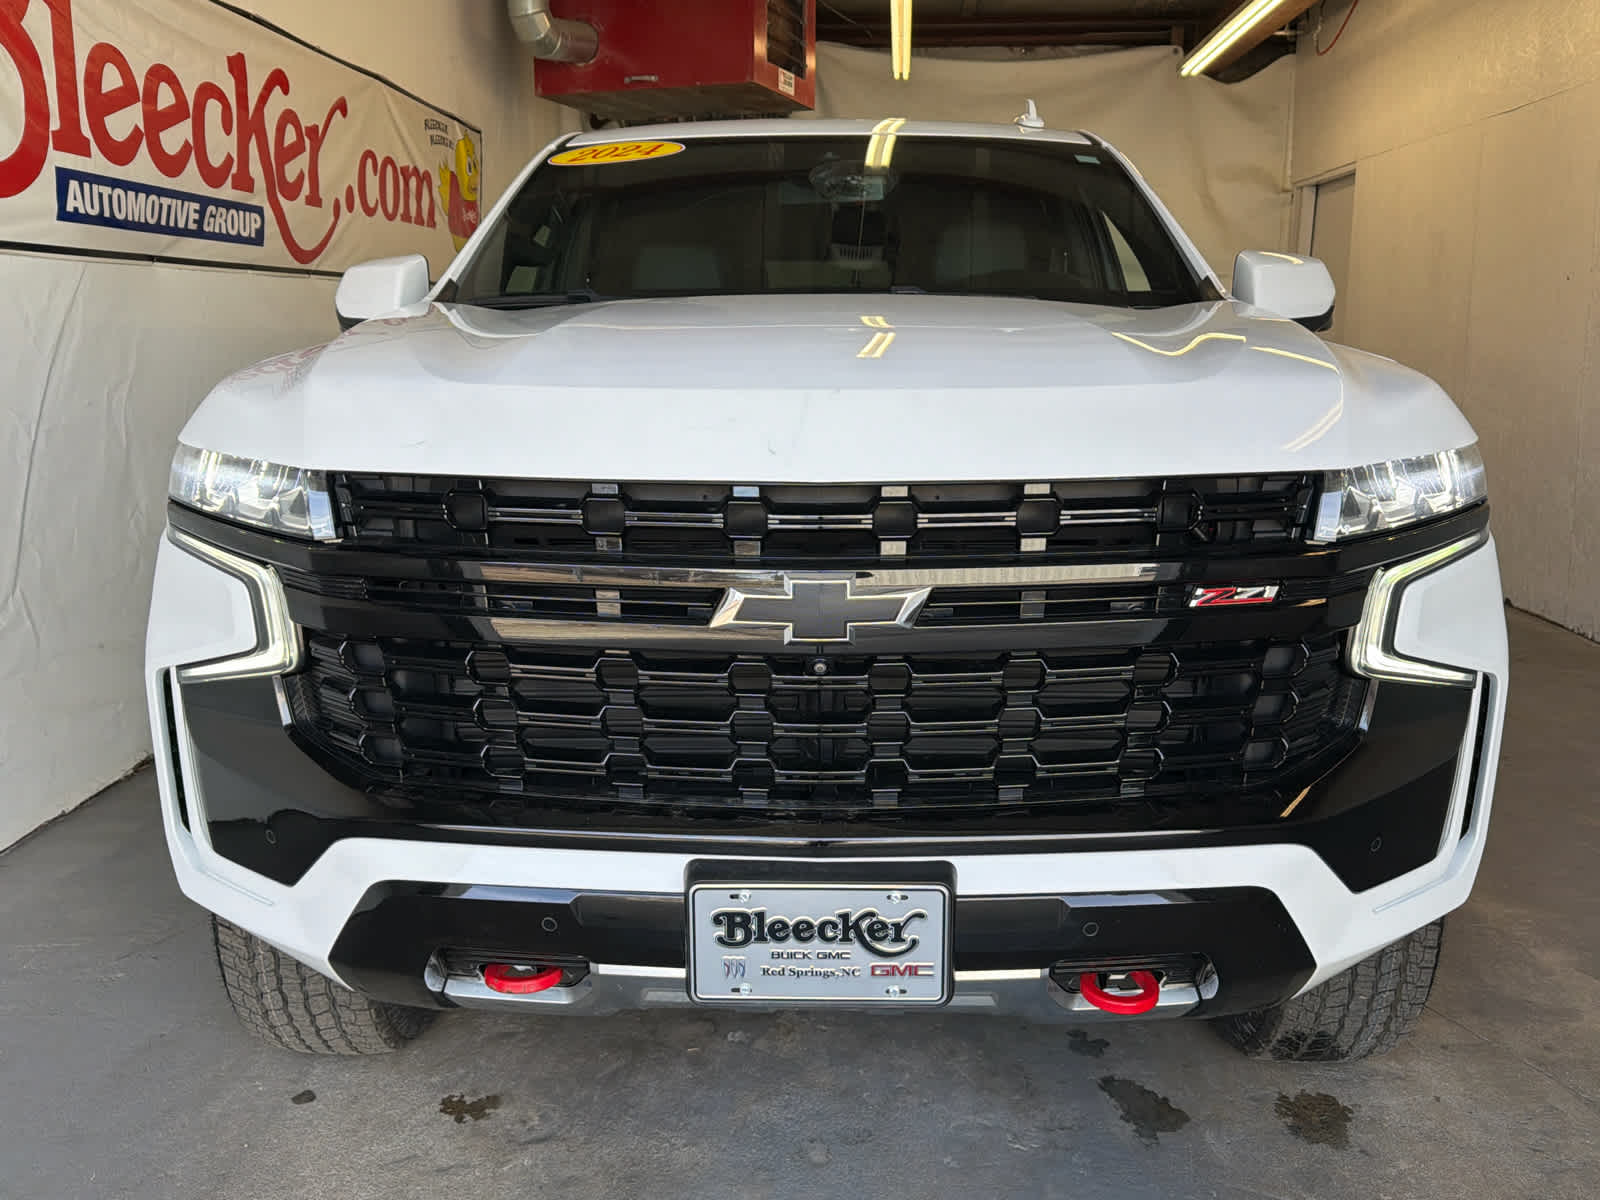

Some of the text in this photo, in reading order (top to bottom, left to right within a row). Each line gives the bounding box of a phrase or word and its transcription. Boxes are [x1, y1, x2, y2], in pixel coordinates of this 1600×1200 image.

[568, 144, 665, 162] 2024
[66, 179, 262, 238] AUTOMOTIVE GROUP
[771, 951, 851, 960] BUICK GMC
[761, 966, 785, 977] Red
[870, 964, 936, 977] GMC
